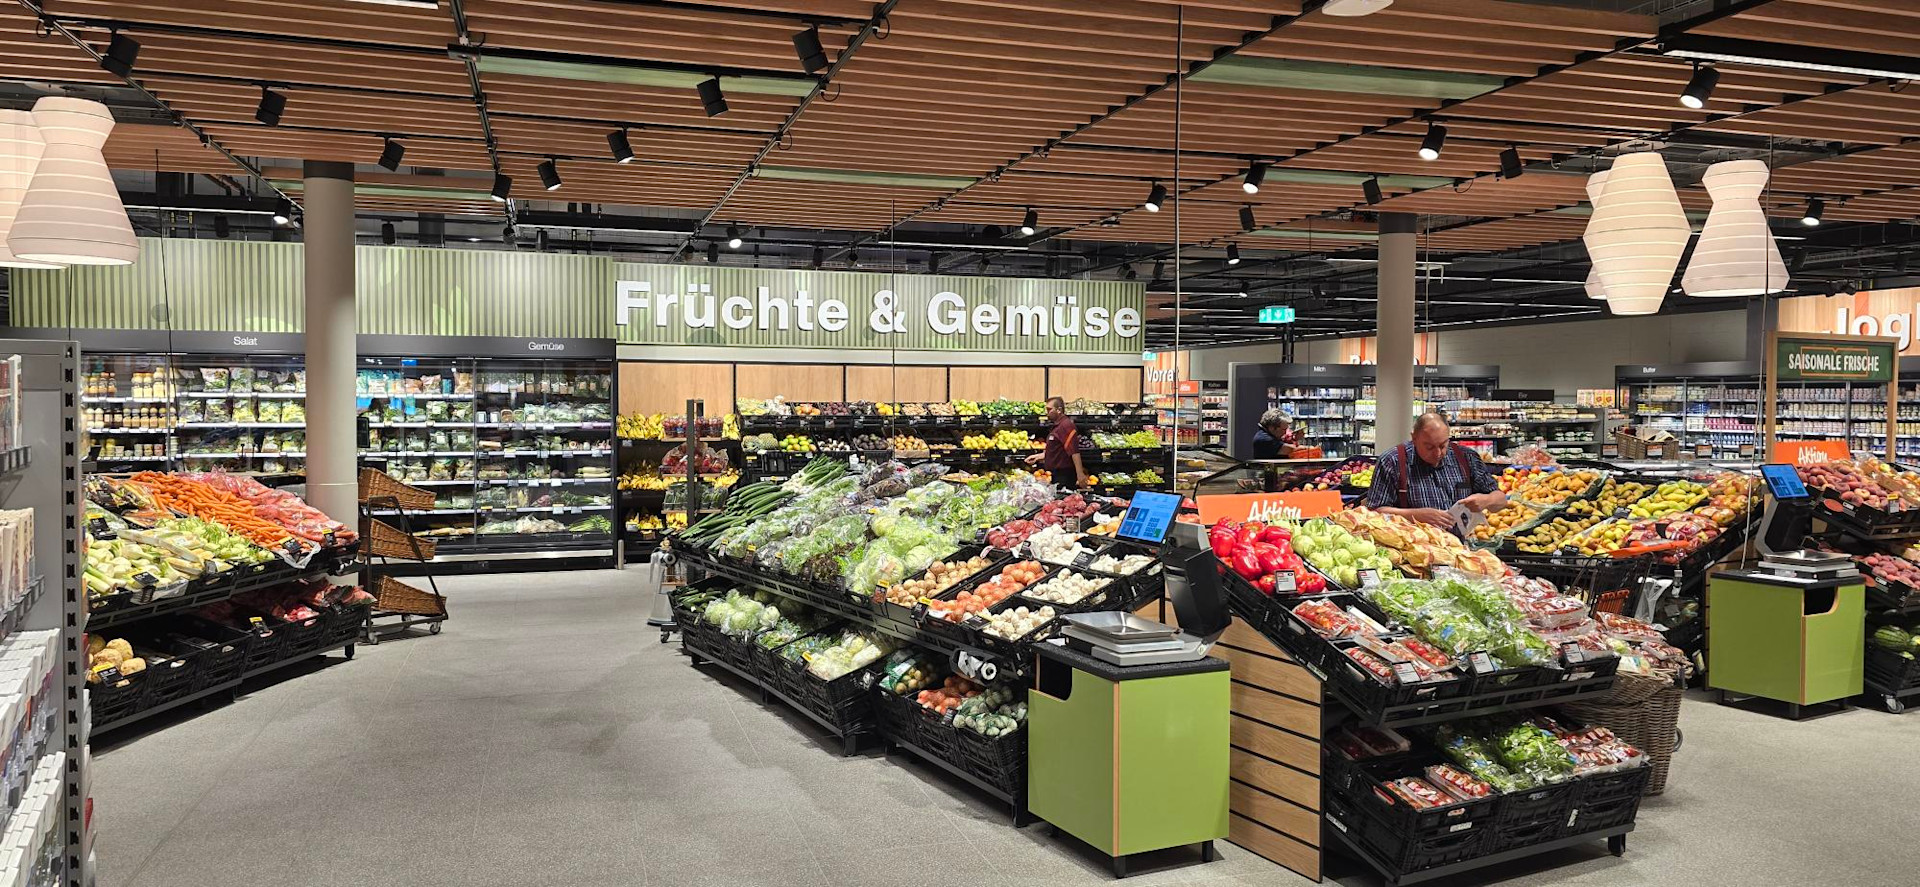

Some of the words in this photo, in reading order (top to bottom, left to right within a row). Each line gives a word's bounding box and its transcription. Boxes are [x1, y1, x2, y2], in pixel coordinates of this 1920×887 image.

[615, 280, 849, 332] Früchte
[869, 289, 907, 334] &
[926, 291, 1142, 338] Gemüse
[233, 336, 258, 346] Salat
[528, 341, 565, 351] Gemüse
[1313, 365, 1327, 373] Milch
[1788, 353, 1842, 371] SAISONALE
[1843, 355, 1880, 372] FRISCHE
[1798, 446, 1829, 465] Aktion
[1247, 499, 1302, 524] Aktion
